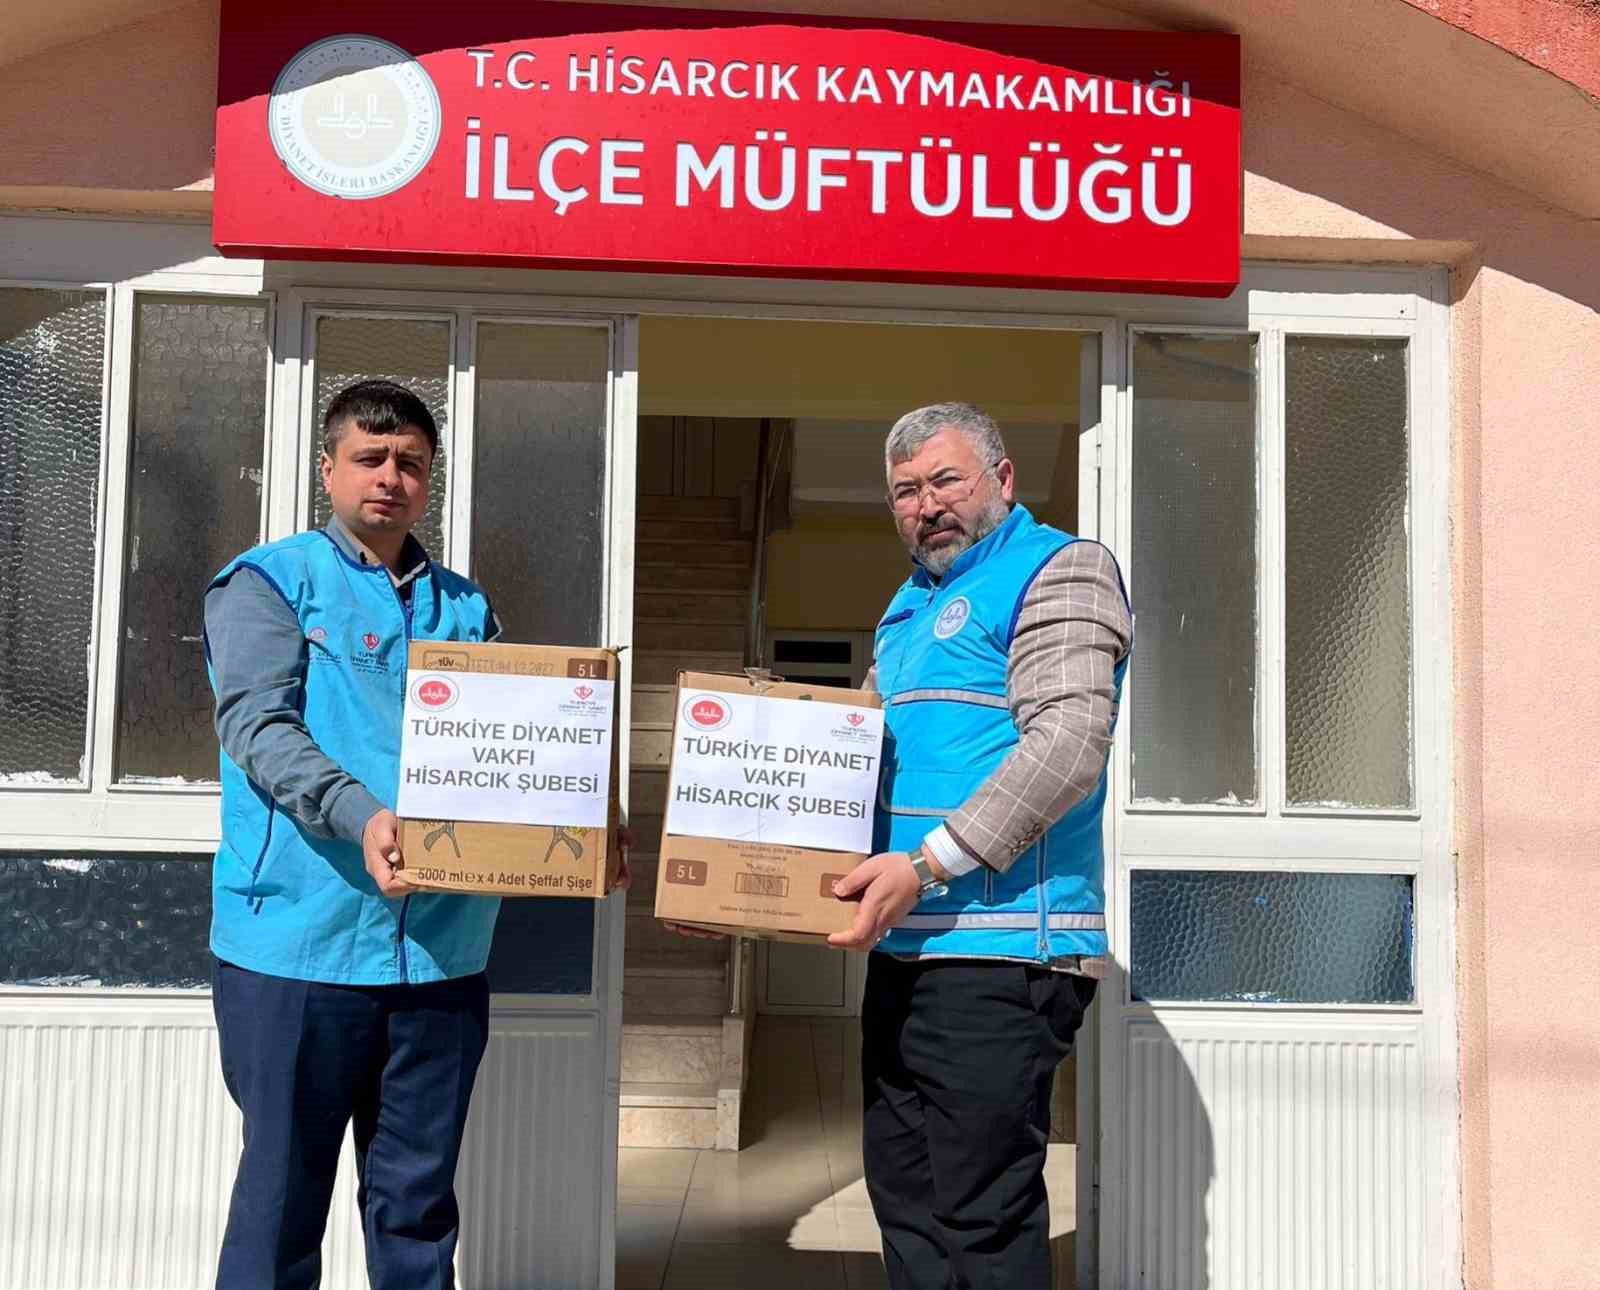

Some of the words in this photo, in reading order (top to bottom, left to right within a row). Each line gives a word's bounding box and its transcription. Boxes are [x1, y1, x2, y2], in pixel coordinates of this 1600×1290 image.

[466, 49, 549, 90] T.C.
[567, 48, 799, 102] HİSARCIK
[816, 65, 1192, 119] KAYMAKAMLIĞI
[465, 117, 645, 216] İLÇE
[675, 129, 1193, 226] MÜFTÜLÜĞÜ
[578, 663, 586, 677] 5
[590, 664, 597, 678] L
[411, 717, 505, 740] TÜRKİYE
[512, 722, 606, 745] DİYANET
[471, 746, 535, 766] VAKFI
[683, 736, 777, 762] TÜRKİYE
[784, 748, 876, 771] DİYANET
[405, 767, 510, 790] HİSARCIK
[517, 773, 599, 794] ŞUBESİ
[743, 767, 806, 789] VAKFI
[676, 784, 780, 811] HİSARCIK
[786, 795, 866, 820] ŞUBESİ
[417, 868, 446, 881] 5000
[497, 872, 526, 886] Adet
[528, 874, 564, 889] Şeffaf
[566, 876, 593, 891] Şişe
[676, 864, 686, 878] 5
[688, 865, 697, 880] L
